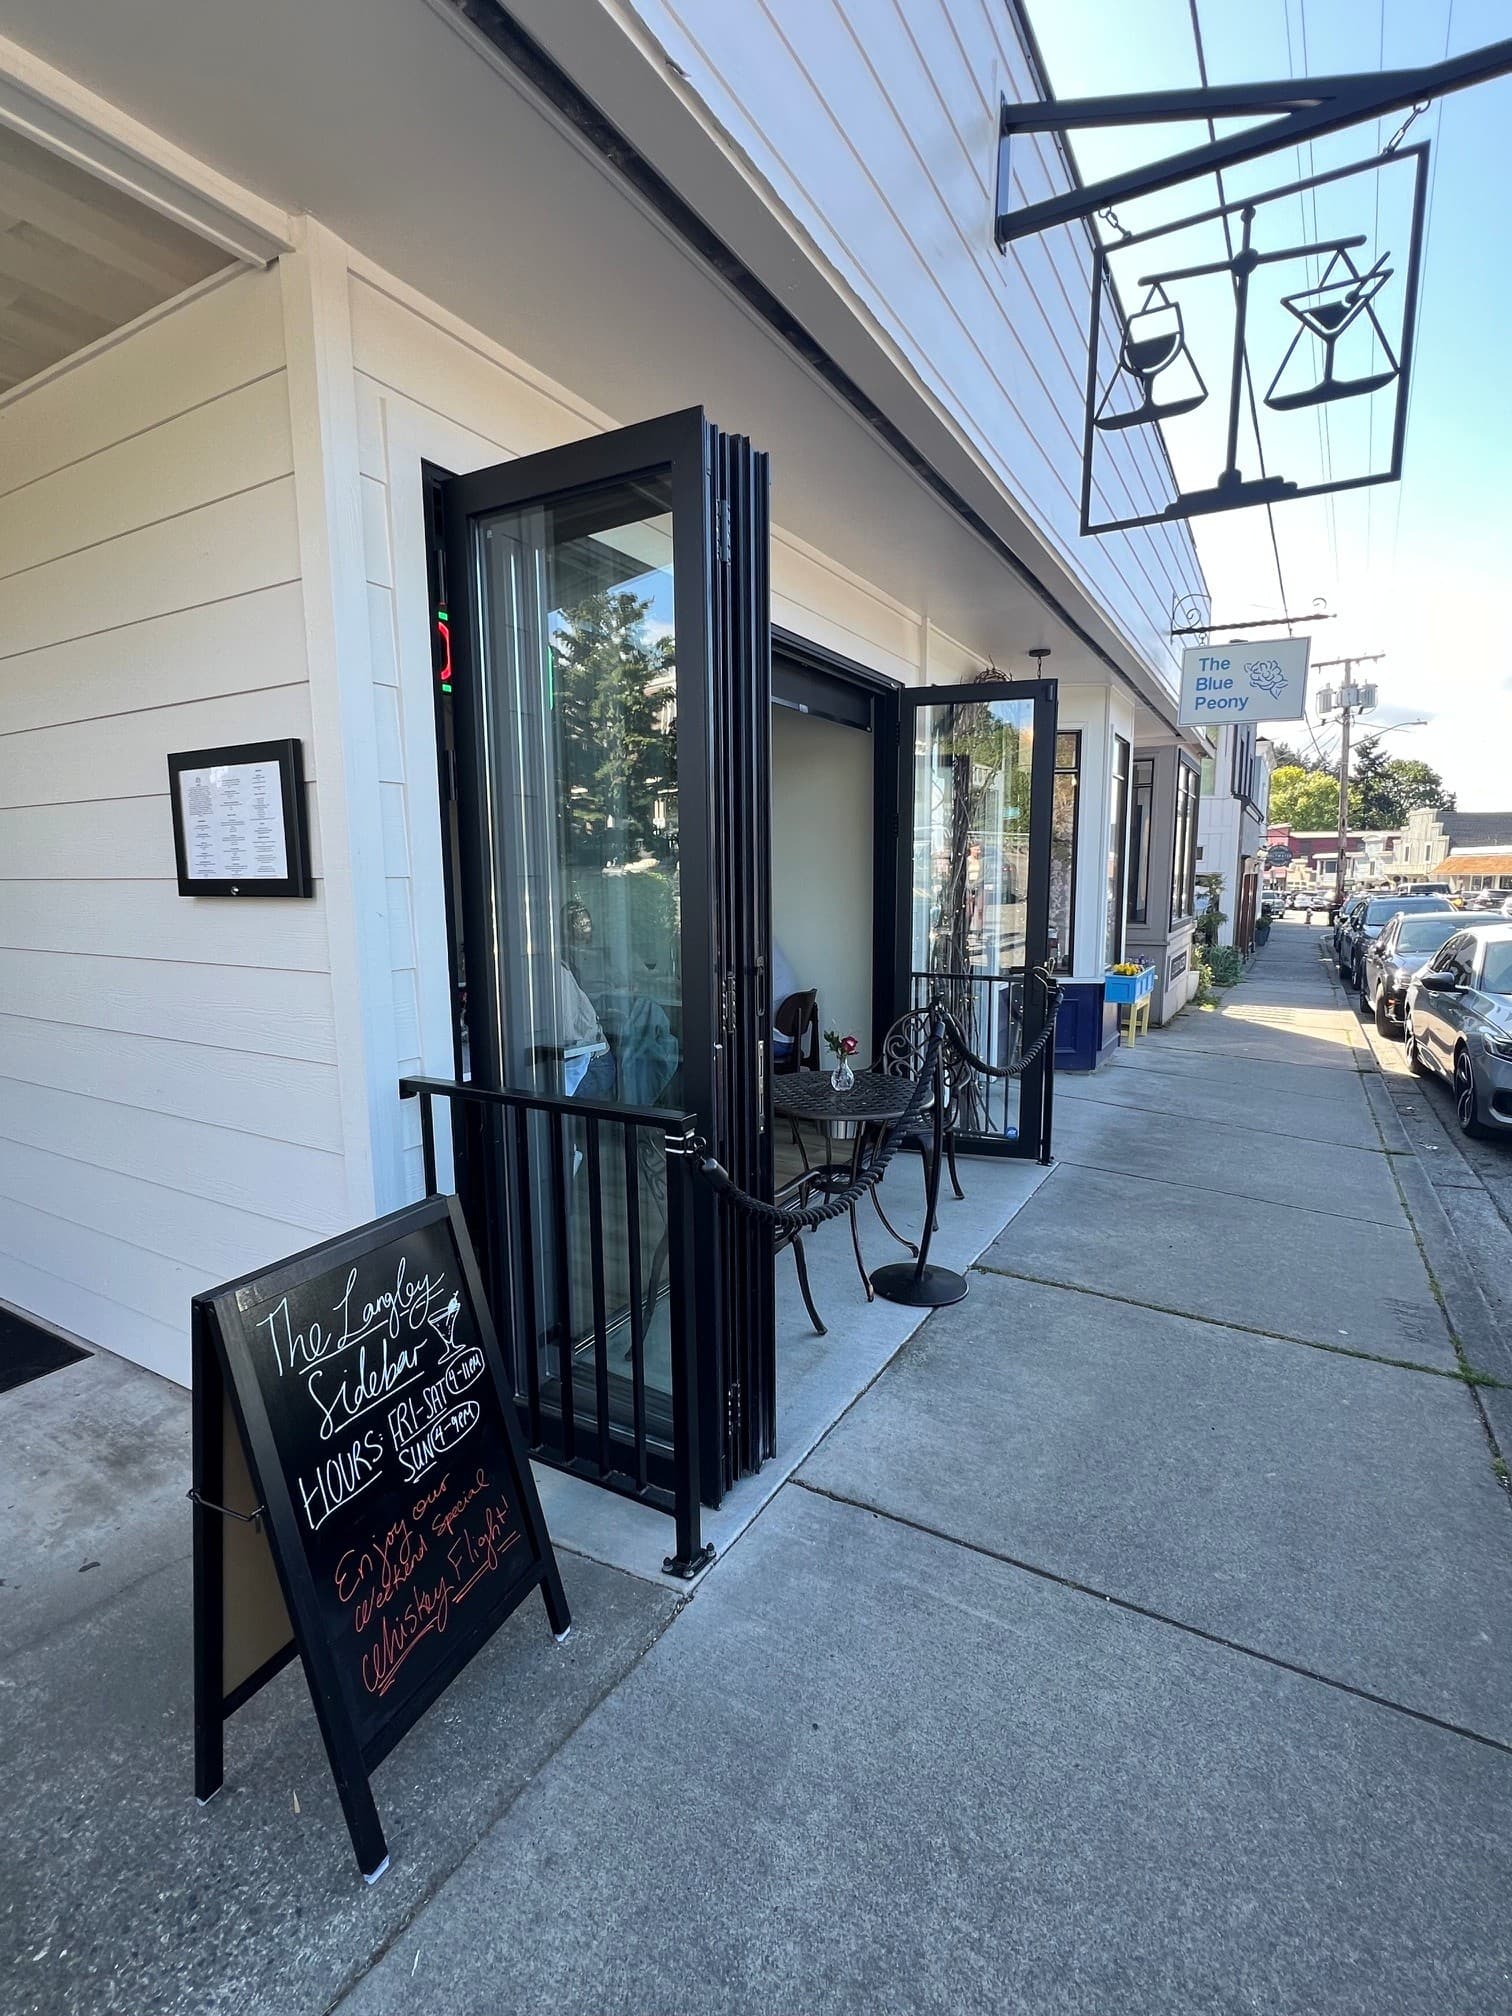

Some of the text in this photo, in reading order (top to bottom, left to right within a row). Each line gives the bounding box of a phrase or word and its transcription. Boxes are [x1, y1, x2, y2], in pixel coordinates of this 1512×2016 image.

[1195, 677, 1234, 691] Blue
[1199, 657, 1231, 672] The
[1194, 696, 1249, 712] Peony
[256, 1256, 445, 1376] The Langley
[308, 1338, 428, 1440] Sidebar
[299, 1430, 384, 1529] HOURS:
[387, 1377, 447, 1452] FRI-SAT
[399, 1433, 435, 1483] SUN
[335, 1473, 450, 1602] Enjoy our
[447, 1495, 509, 1570] Flight!
